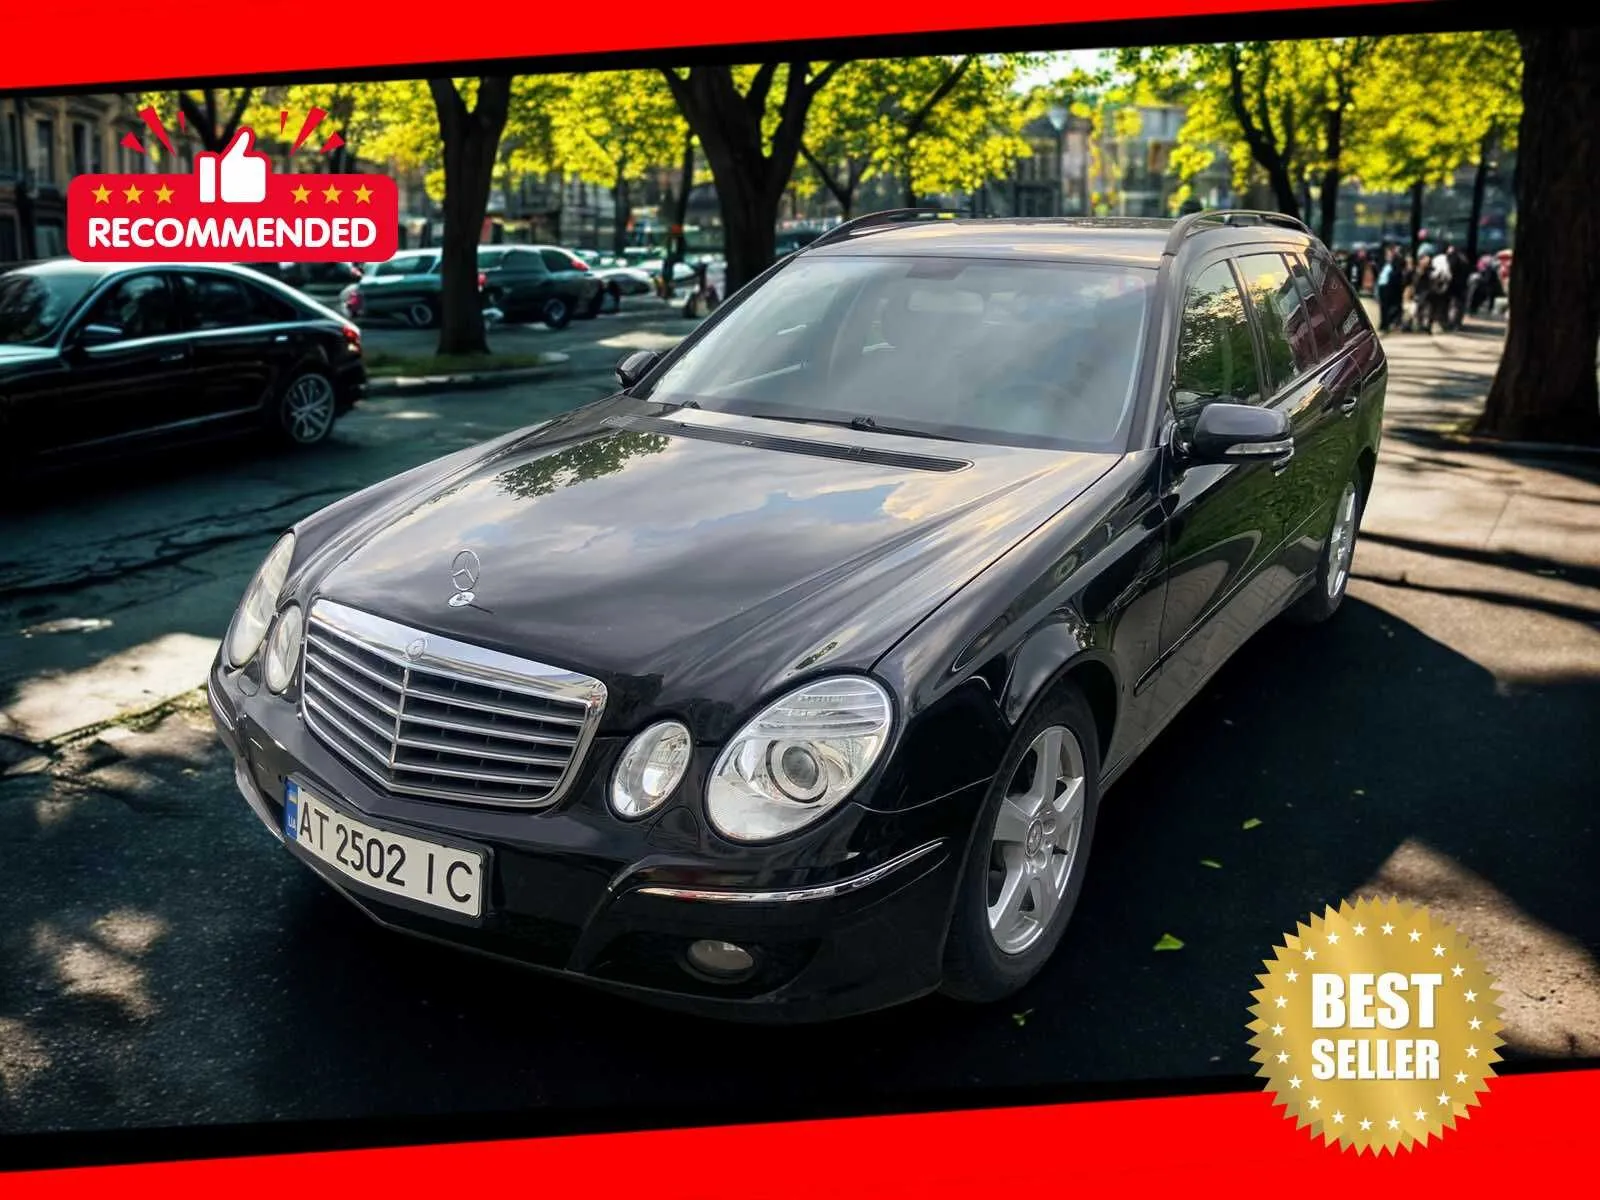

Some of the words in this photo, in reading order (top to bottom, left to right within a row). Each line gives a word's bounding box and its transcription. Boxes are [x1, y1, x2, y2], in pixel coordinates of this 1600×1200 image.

[300, 801, 330, 850] AT
[335, 823, 406, 886] 2502
[426, 853, 473, 903] IC
